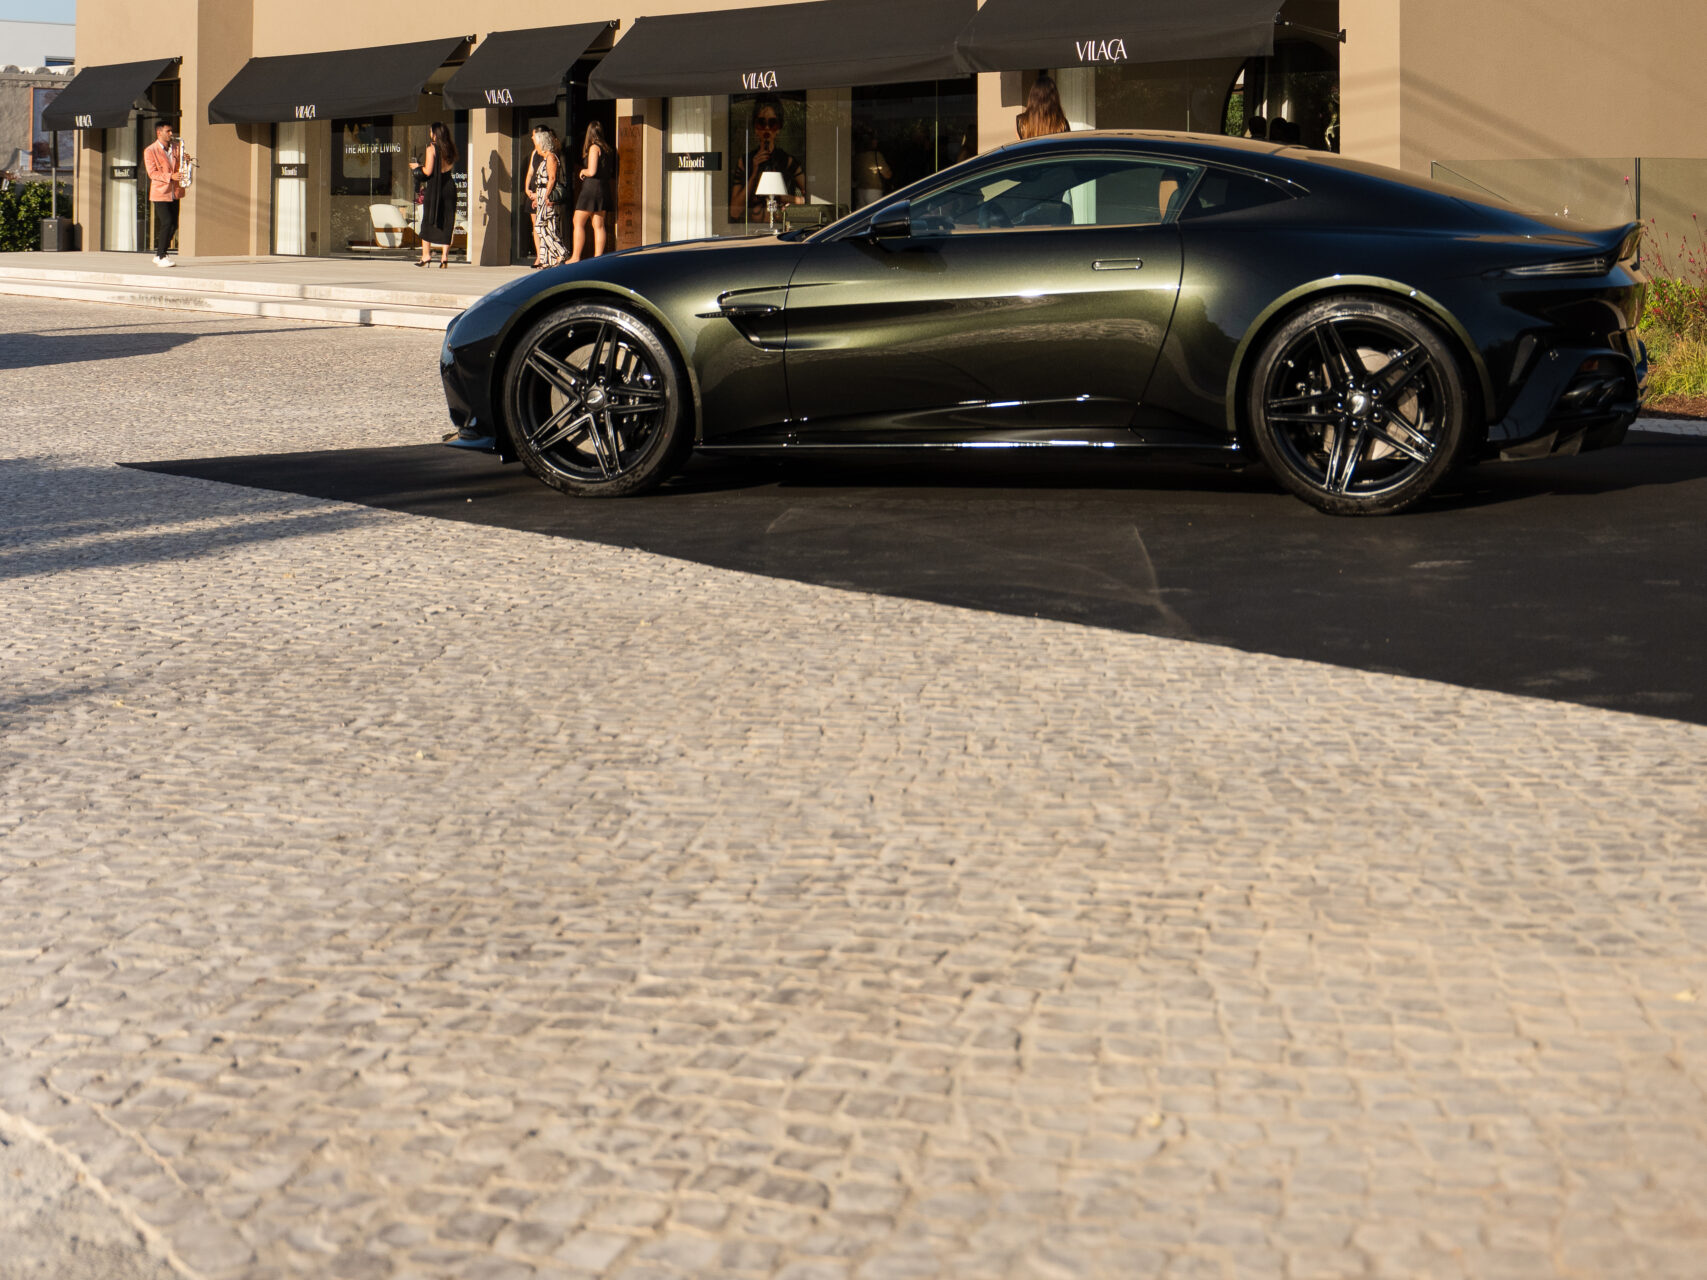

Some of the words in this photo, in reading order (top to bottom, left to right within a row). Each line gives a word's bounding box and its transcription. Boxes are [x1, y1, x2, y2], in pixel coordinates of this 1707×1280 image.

[1075, 38, 1128, 64] VILAÇA
[742, 70, 778, 91] VILAÇA
[484, 88, 514, 106] VILAÇA
[345, 144, 356, 154] THE
[358, 144, 370, 154] ART
[371, 143, 379, 154] OF
[380, 142, 401, 153] LIVING
[678, 155, 705, 169] Minotti
